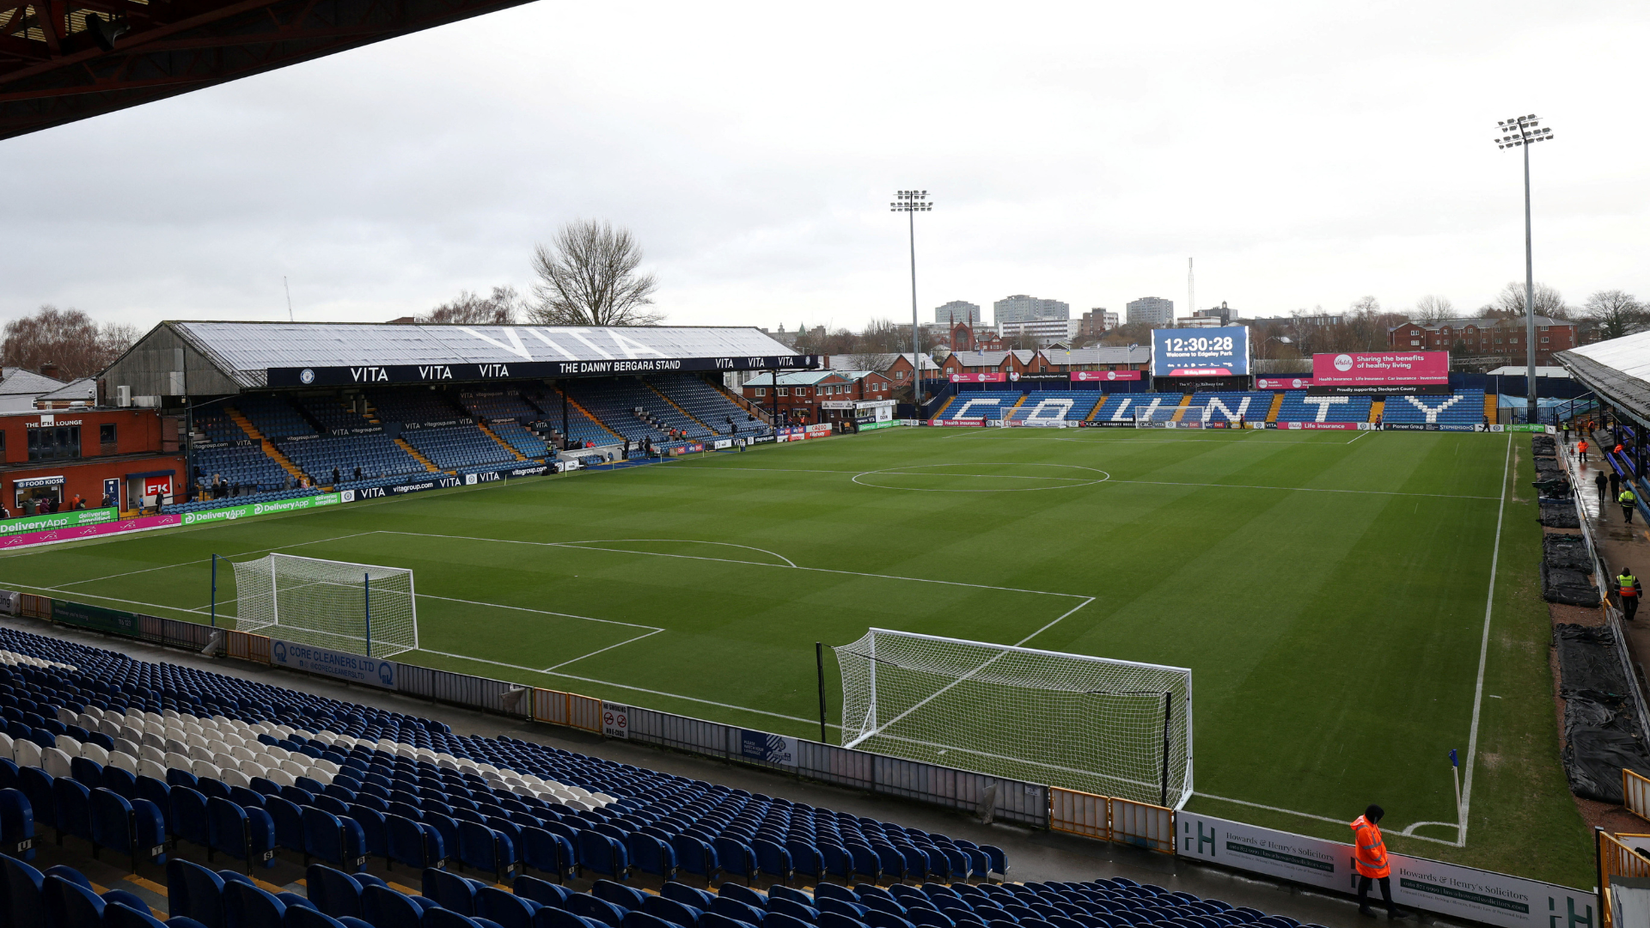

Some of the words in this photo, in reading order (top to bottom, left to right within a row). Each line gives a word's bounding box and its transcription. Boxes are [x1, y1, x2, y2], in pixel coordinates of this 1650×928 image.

[1164, 336, 1233, 352] 12:30:28
[559, 363, 578, 374] THE
[580, 362, 612, 373] DANNY
[614, 361, 654, 372] BERGARA
[656, 360, 681, 370] STAND
[715, 358, 734, 369] VITA
[748, 357, 764, 368] VITA
[778, 356, 794, 366] VITA
[350, 367, 388, 382] VITA
[418, 366, 452, 380] VITA
[478, 364, 510, 378] VITA
[147, 484, 168, 494] FK
[361, 487, 386, 499] VITA
[393, 482, 433, 494] vitagroup.com
[440, 477, 461, 487] VITA
[480, 472, 500, 481] VITA
[512, 466, 548, 476] vitagroup.com
[264, 500, 309, 511] DeliveryApp
[78, 510, 111, 519] deliveries
[196, 509, 246, 521] DeliveryApp
[0, 518, 68, 533] DeliveryApp
[290, 646, 312, 659] CORE
[313, 651, 356, 669] CLEANERS
[359, 660, 375, 672] LTD
[310, 662, 365, 680] @CORECLEANERSLTD
[609, 703, 626, 713] SMOKING
[612, 728, 624, 737] E-CIGS
[21, 841, 29, 850] U
[1226, 832, 1258, 845] Howards
[1268, 841, 1296, 853] Henry's
[1298, 848, 1334, 861] Solicitors
[1400, 868, 1437, 882] Howards
[1450, 878, 1482, 891] Henry's
[1485, 886, 1528, 901] Solicitors
